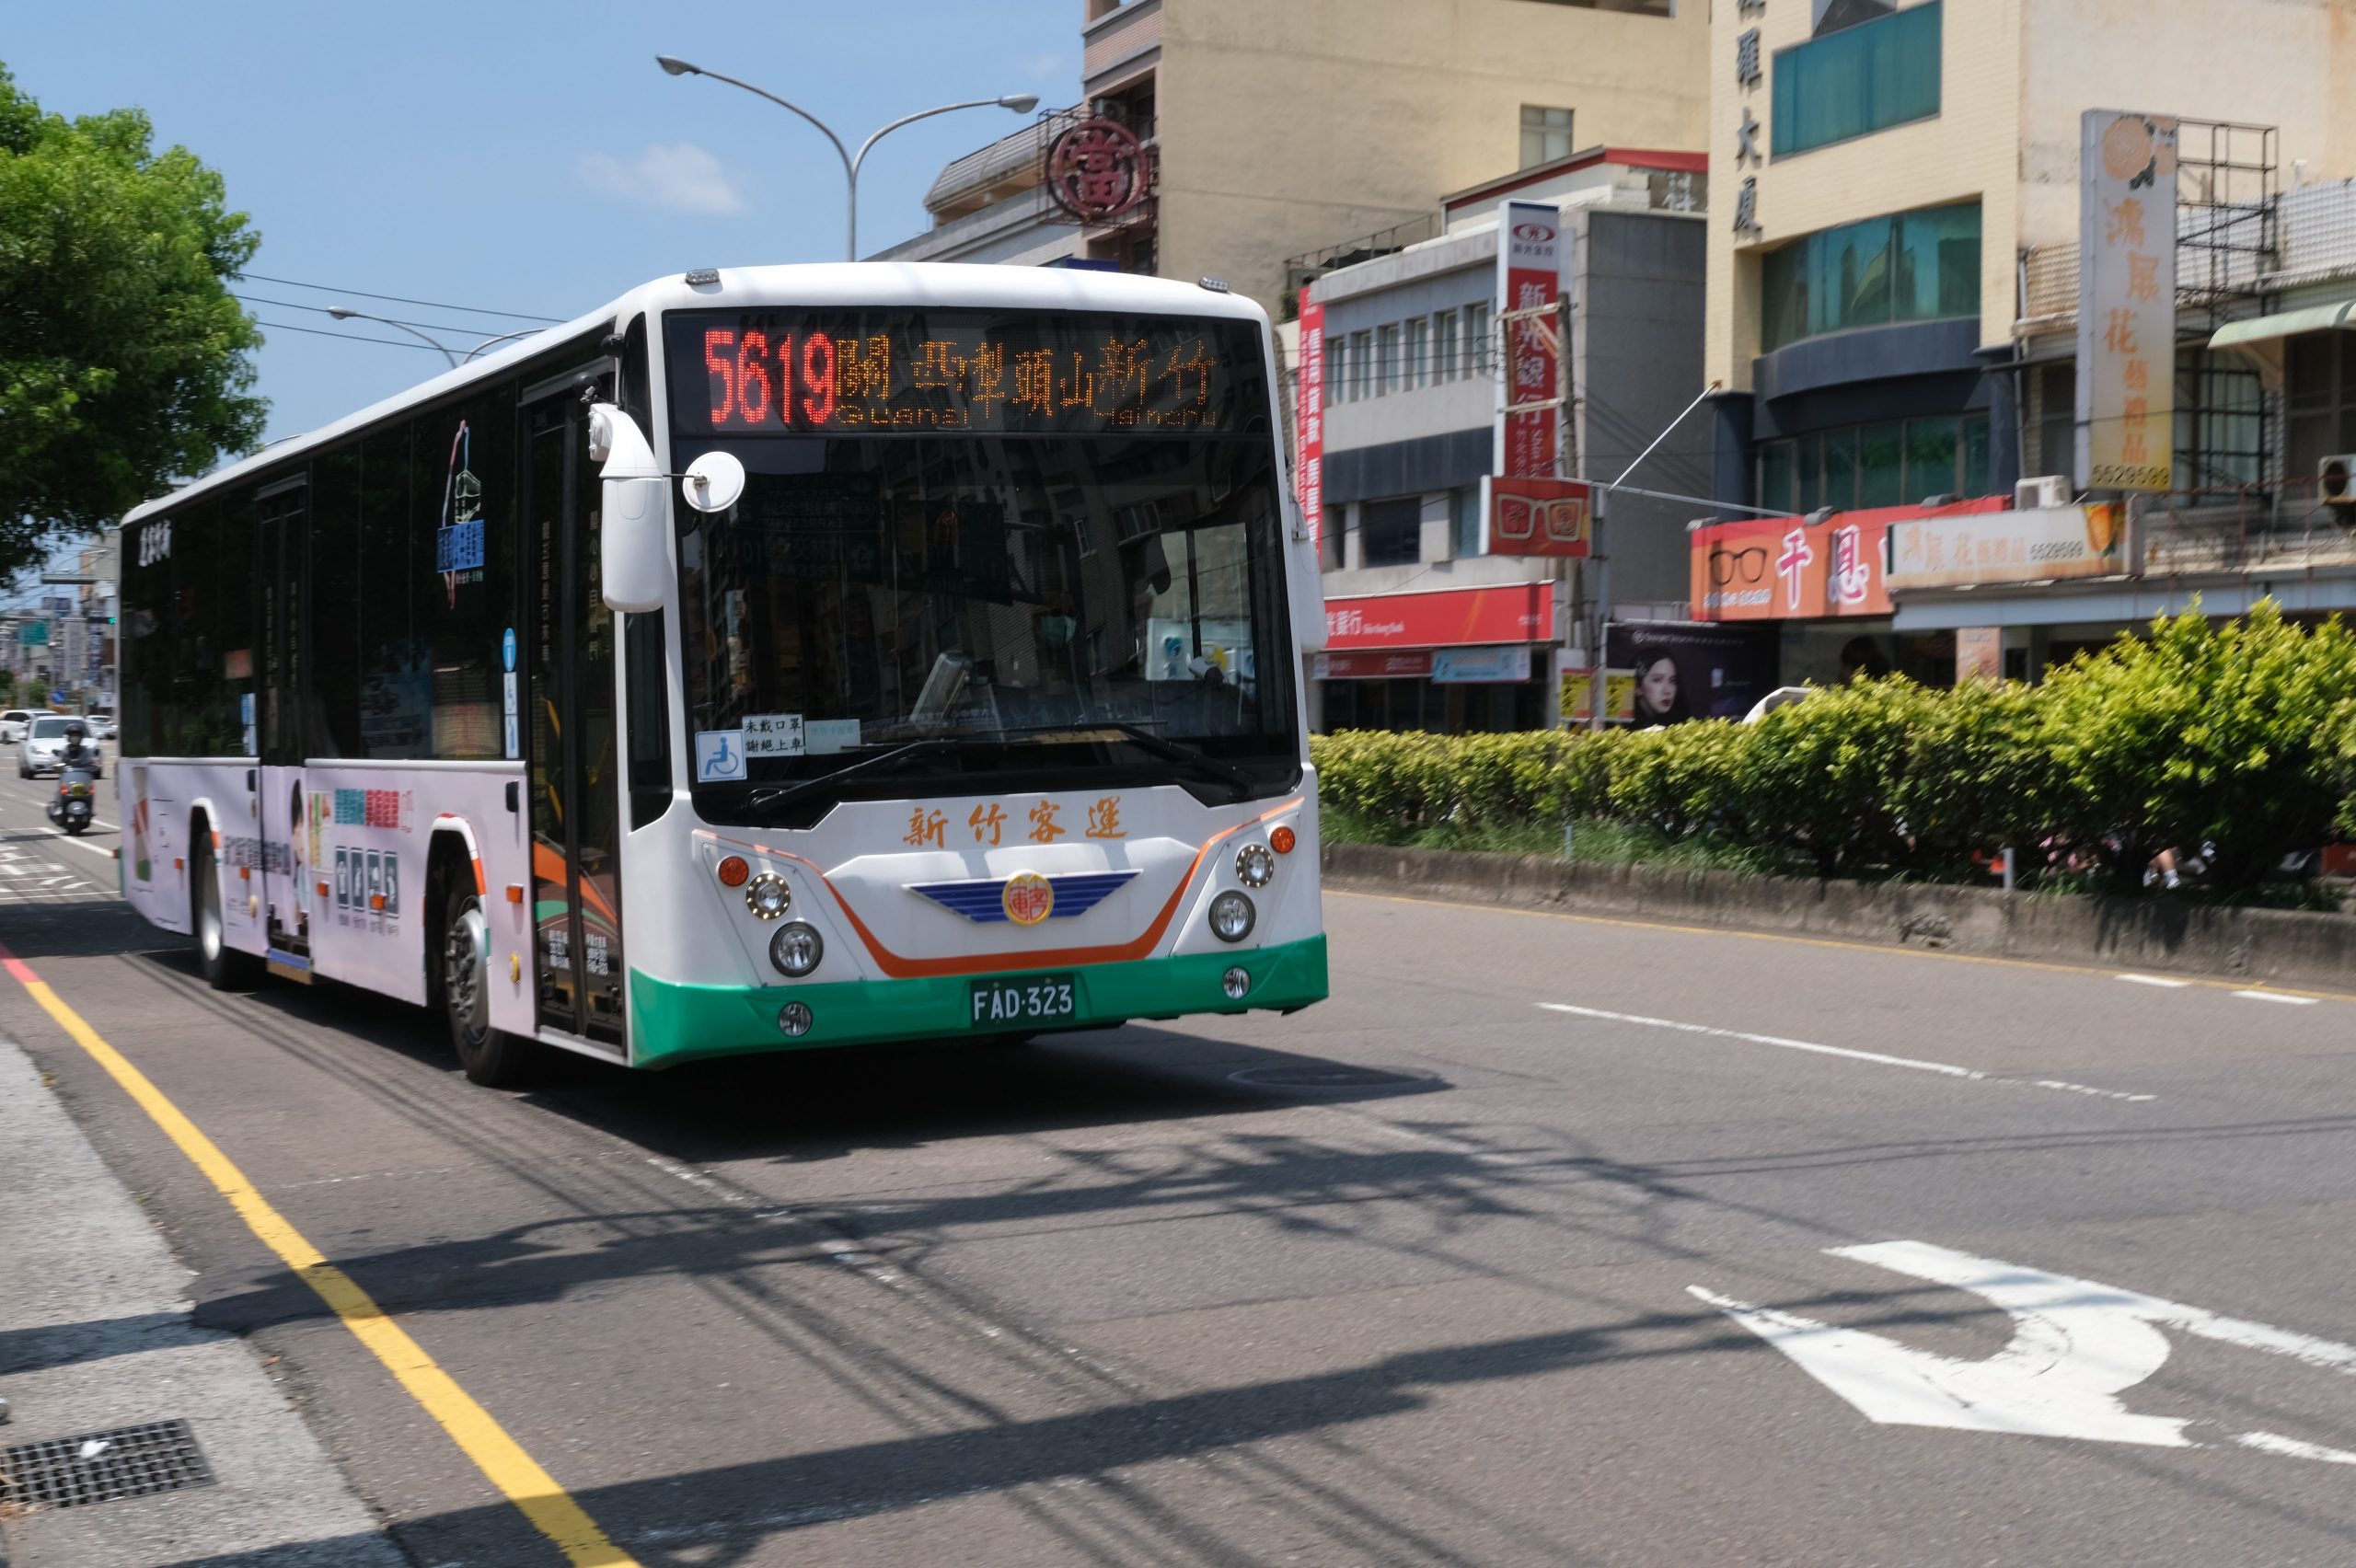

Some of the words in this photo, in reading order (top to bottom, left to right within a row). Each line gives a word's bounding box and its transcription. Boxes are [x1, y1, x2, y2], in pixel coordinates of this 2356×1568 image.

[705, 330, 833, 423] 5619
[745, 717, 802, 733] 未戴口罩
[745, 737, 803, 753] 謝絕上車
[902, 795, 1128, 848] 新竹客運
